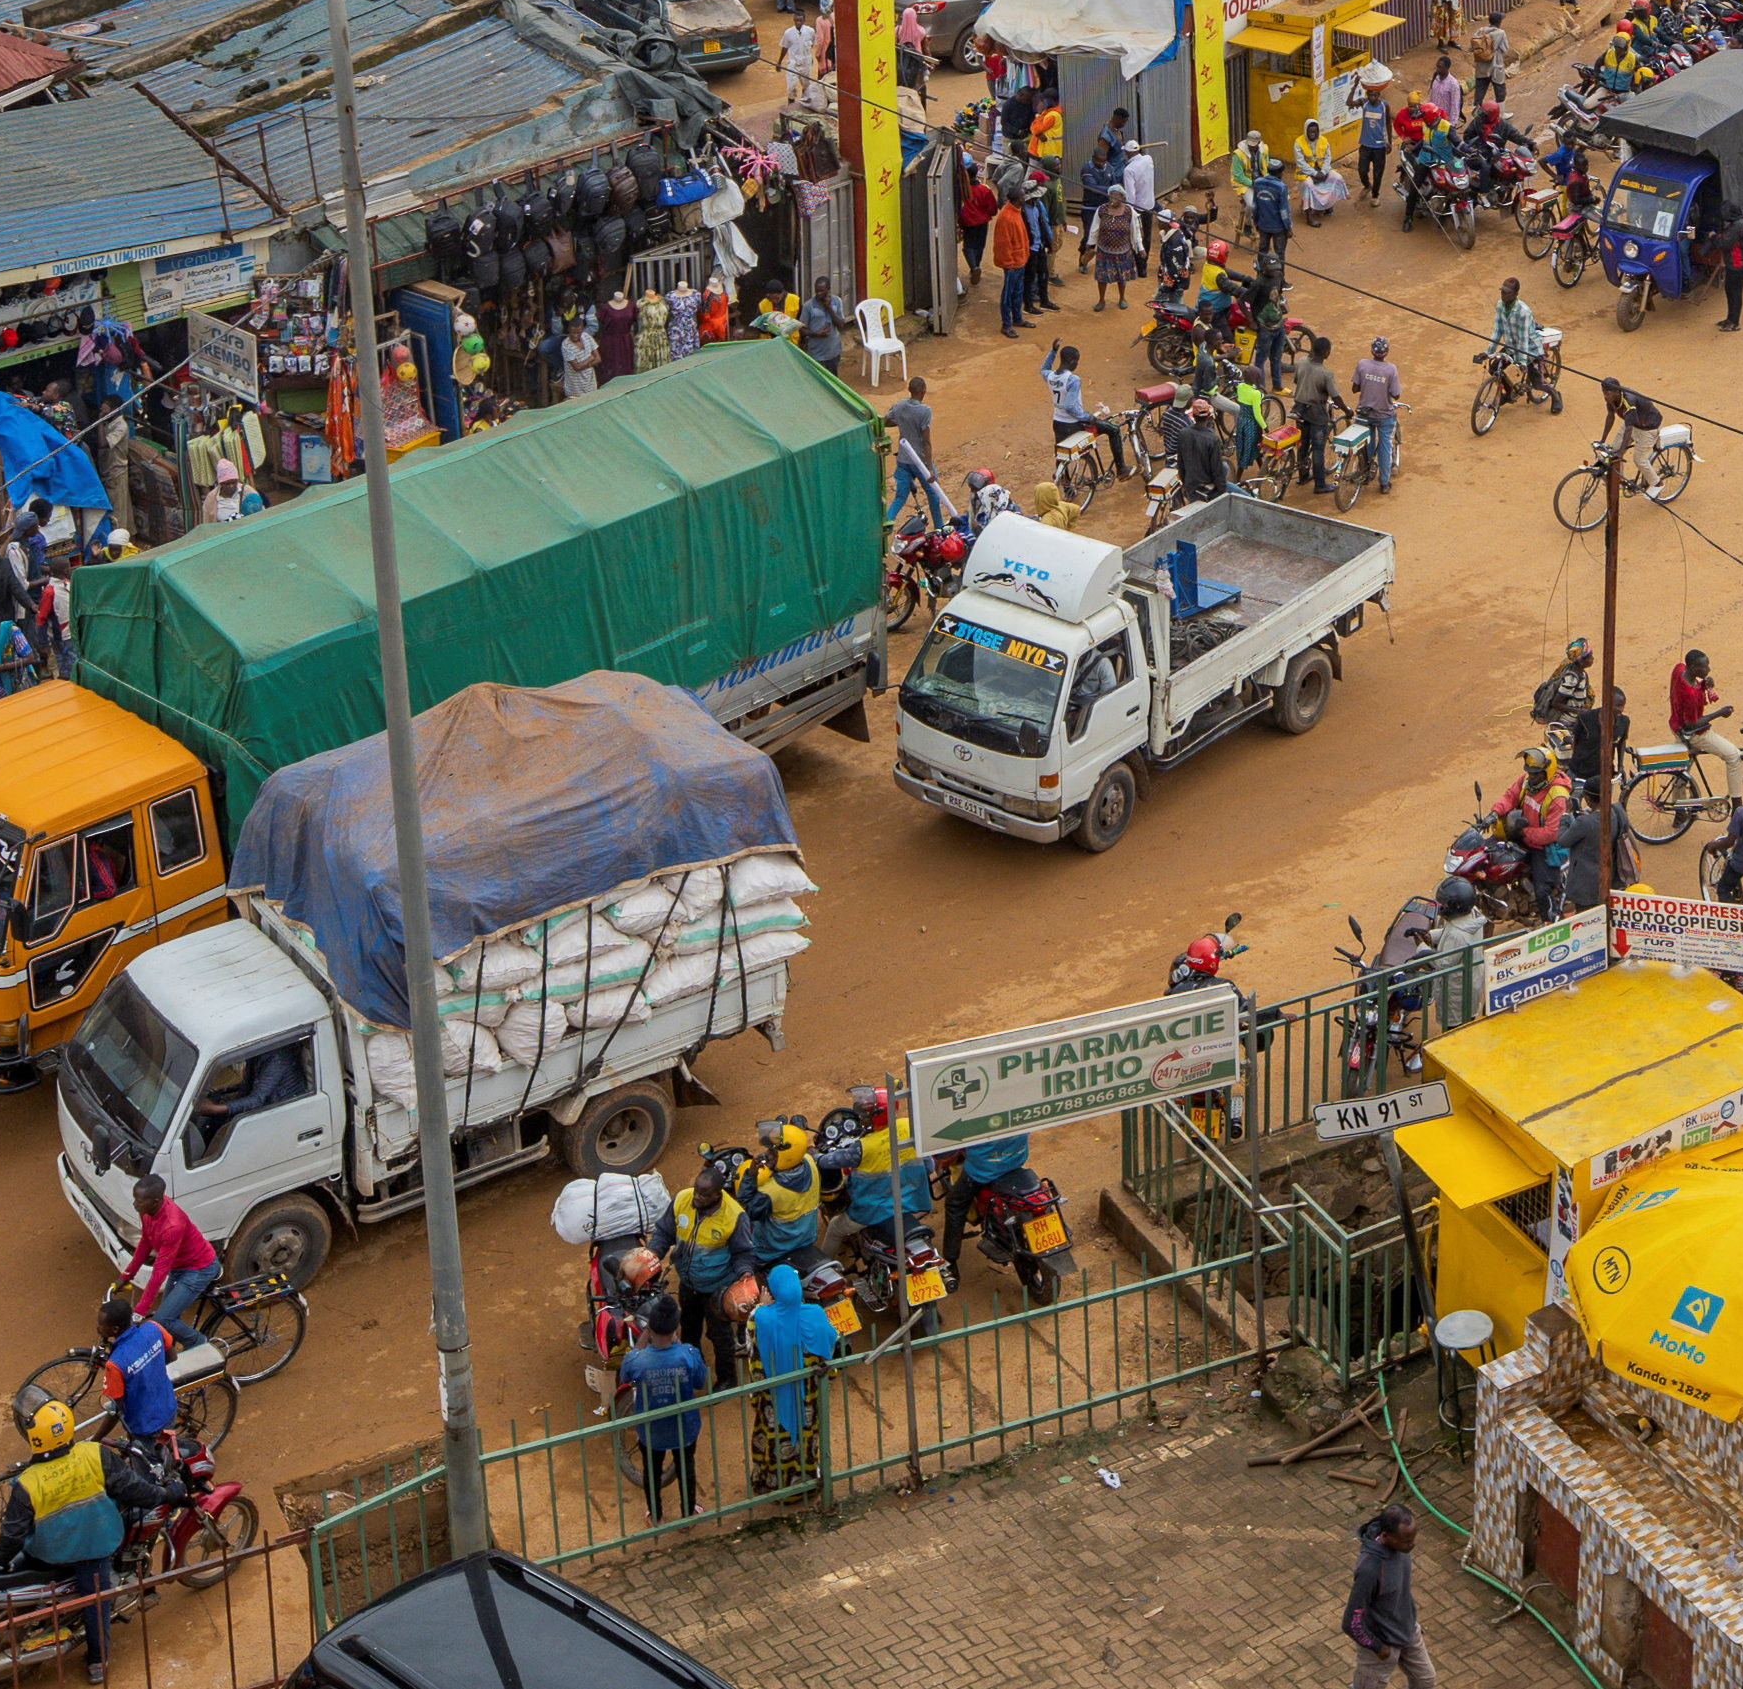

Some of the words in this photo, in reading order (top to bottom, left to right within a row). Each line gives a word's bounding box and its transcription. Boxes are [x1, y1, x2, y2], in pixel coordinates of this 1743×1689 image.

[51, 253, 113, 277] DUCURUZA
[187, 263, 236, 279] MoneyGram
[211, 327, 245, 350] rura
[1003, 557, 1050, 581] YEYO
[1006, 640, 1046, 666] NIYO
[1534, 928, 1564, 947] bpr
[1611, 920, 1684, 935] IREMBO
[1644, 937, 1675, 948] rura
[1496, 966, 1515, 981] BK
[1516, 955, 1547, 973] Yacu
[1493, 973, 1569, 1009] irembo
[997, 1010, 1225, 1081] PHARMACIE
[1042, 1055, 1144, 1099] IRIHO
[1012, 1104, 1052, 1122] +250
[1056, 1095, 1084, 1116] 788
[1086, 1088, 1116, 1107] 966
[1117, 1082, 1147, 1101] 865
[1337, 1105, 1369, 1131] KN
[1377, 1098, 1401, 1123] 91
[1408, 1092, 1423, 1108] ST
[1685, 1115, 1698, 1129] BK
[1683, 1130, 1708, 1148] bpr
[1033, 1219, 1049, 1236] RH
[1034, 1231, 1062, 1252] 668U
[911, 1274, 927, 1287] RG
[1601, 1254, 1622, 1285] MTN
[911, 1285, 941, 1303] 877S
[1648, 1329, 1706, 1366] MoMo
[1626, 1360, 1668, 1387] Kanda
